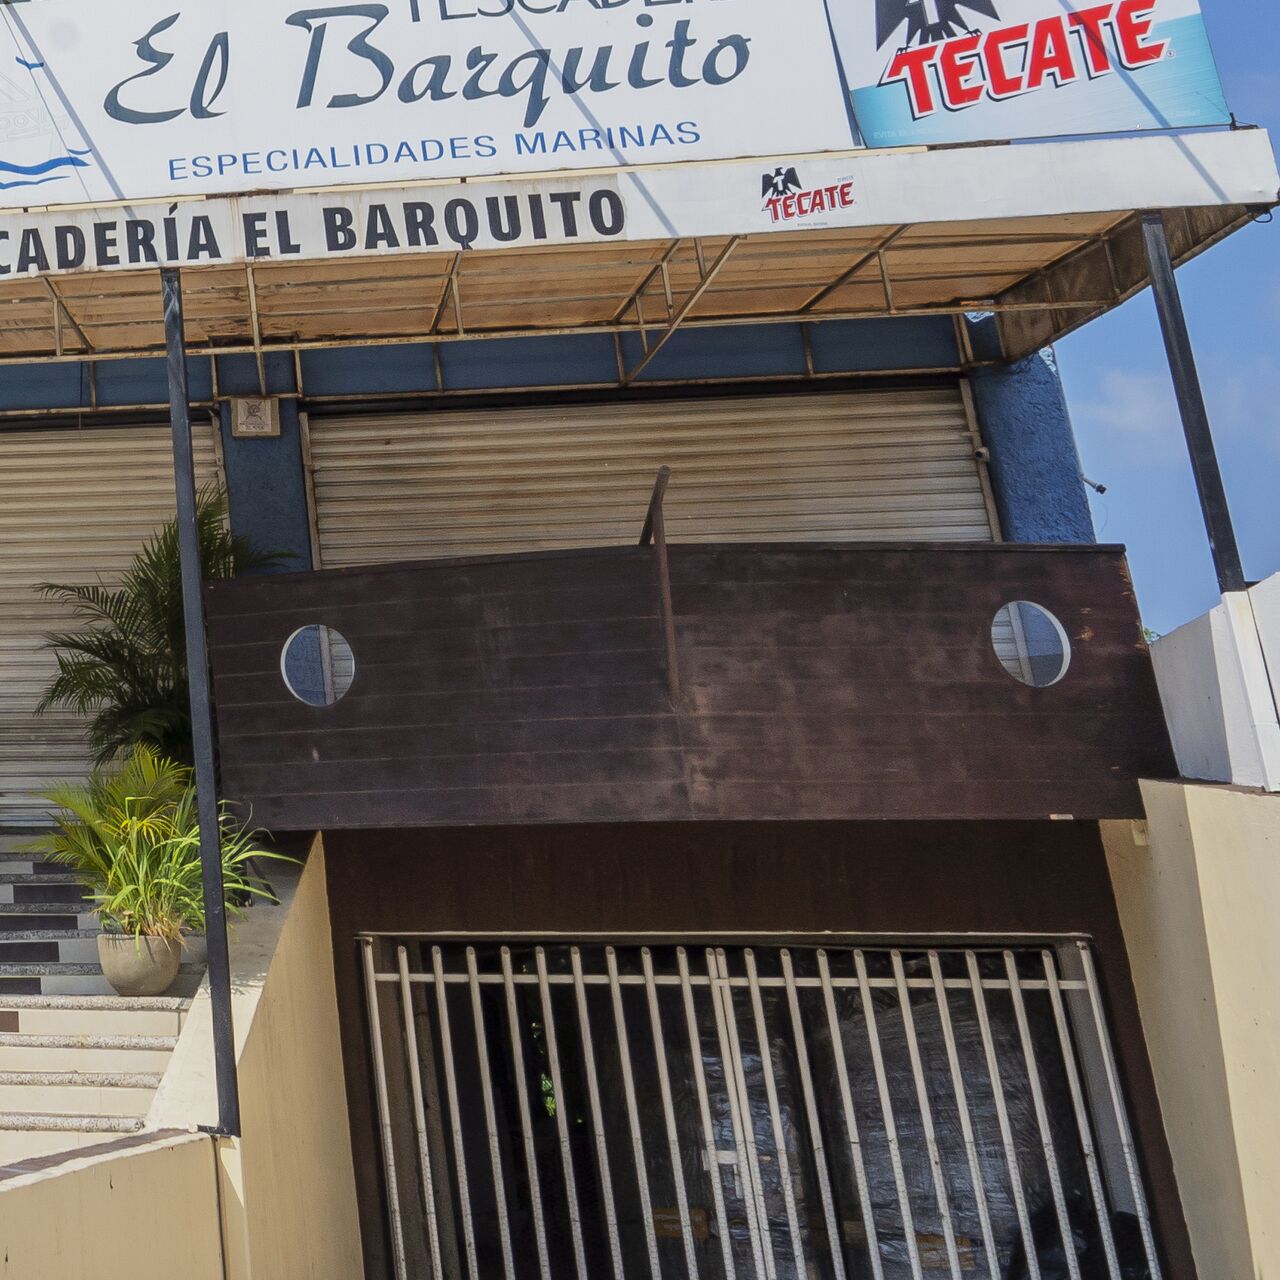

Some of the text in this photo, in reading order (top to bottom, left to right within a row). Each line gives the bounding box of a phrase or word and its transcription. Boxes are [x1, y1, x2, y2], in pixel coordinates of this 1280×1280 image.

[103, 3, 752, 128] El Barquito
[168, 121, 701, 181] ESPECIALIDADES MARINAS
[243, 210, 301, 258] EL
[324, 188, 626, 252] BARQUITO
[763, 182, 854, 222] TECATE
